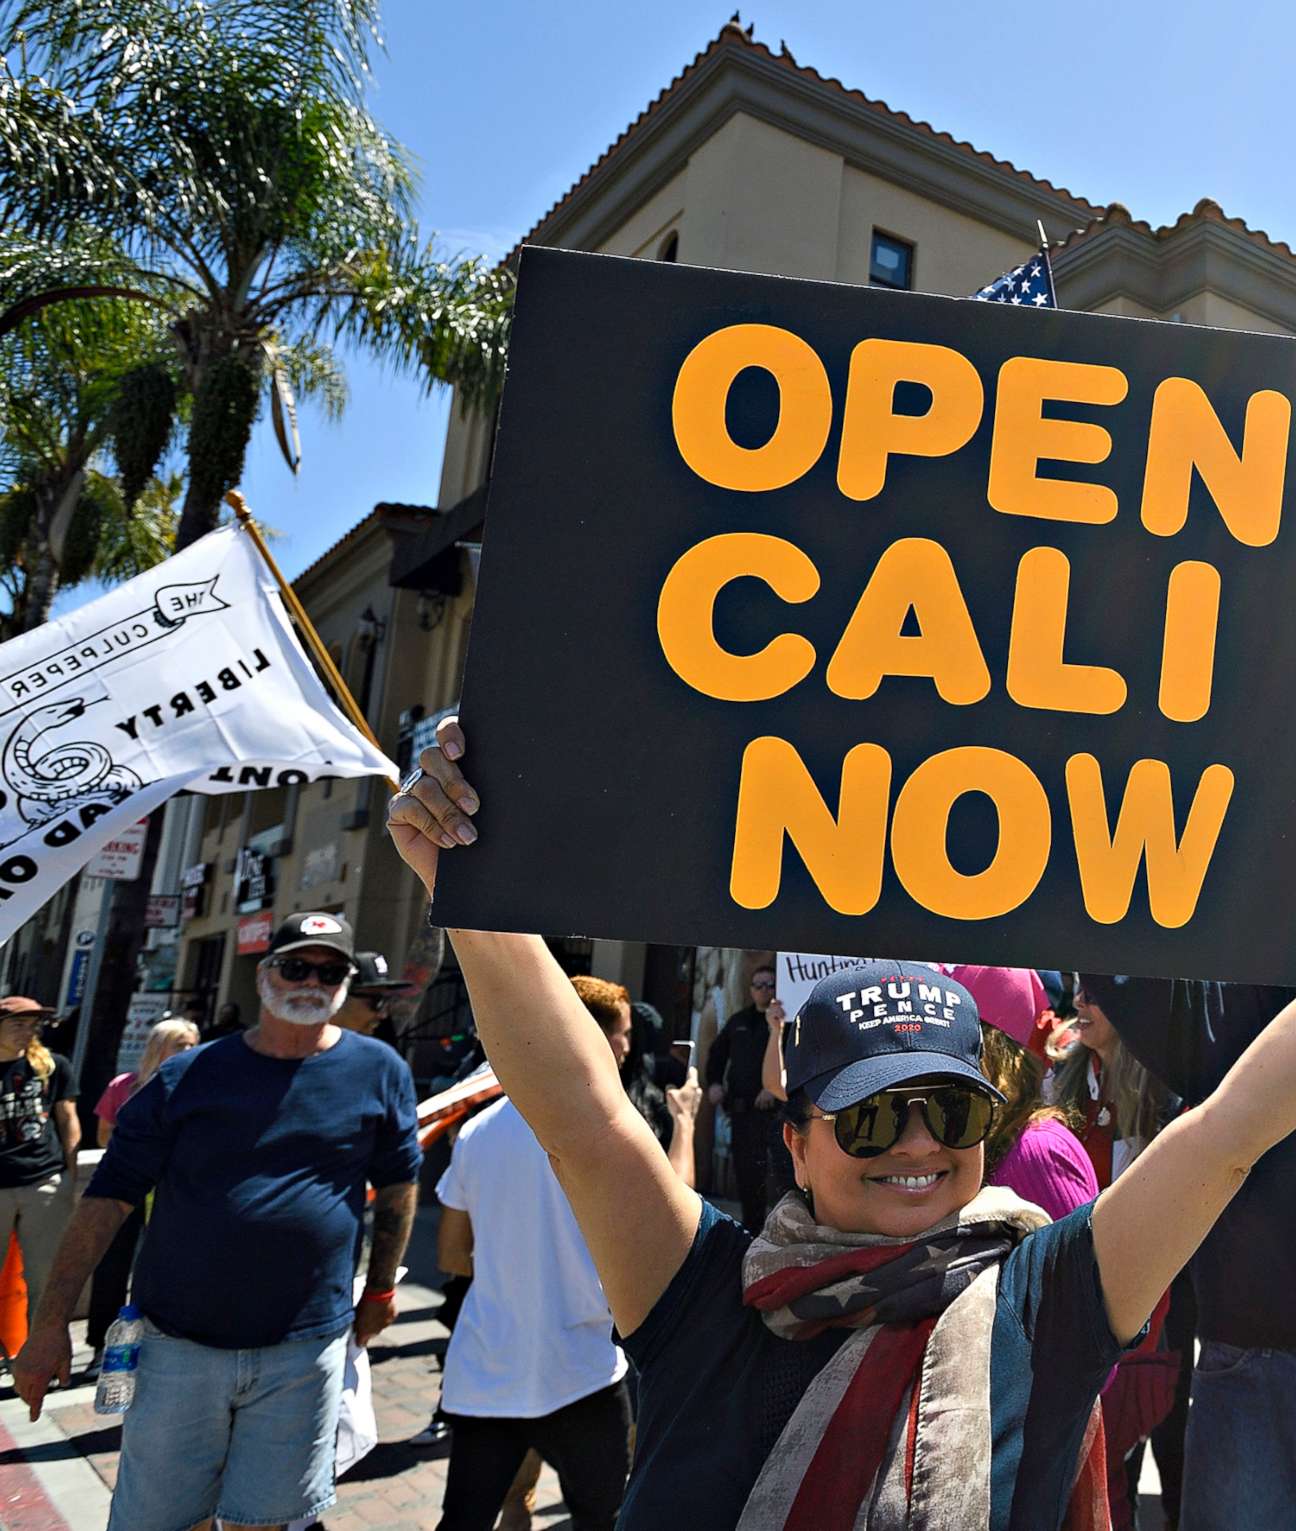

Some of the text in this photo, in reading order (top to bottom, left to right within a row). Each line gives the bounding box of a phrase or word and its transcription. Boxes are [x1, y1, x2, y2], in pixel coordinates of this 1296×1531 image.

[671, 323, 1292, 547] OPEN
[657, 532, 1221, 723] CALI
[729, 736, 1234, 929] NOW
[836, 982, 961, 1012] TRUMP
[850, 1000, 956, 1023] PENCE
[858, 1020, 880, 1031] KEEP
[882, 1014, 923, 1024] AMERICA
[894, 1023, 922, 1033] 2020
